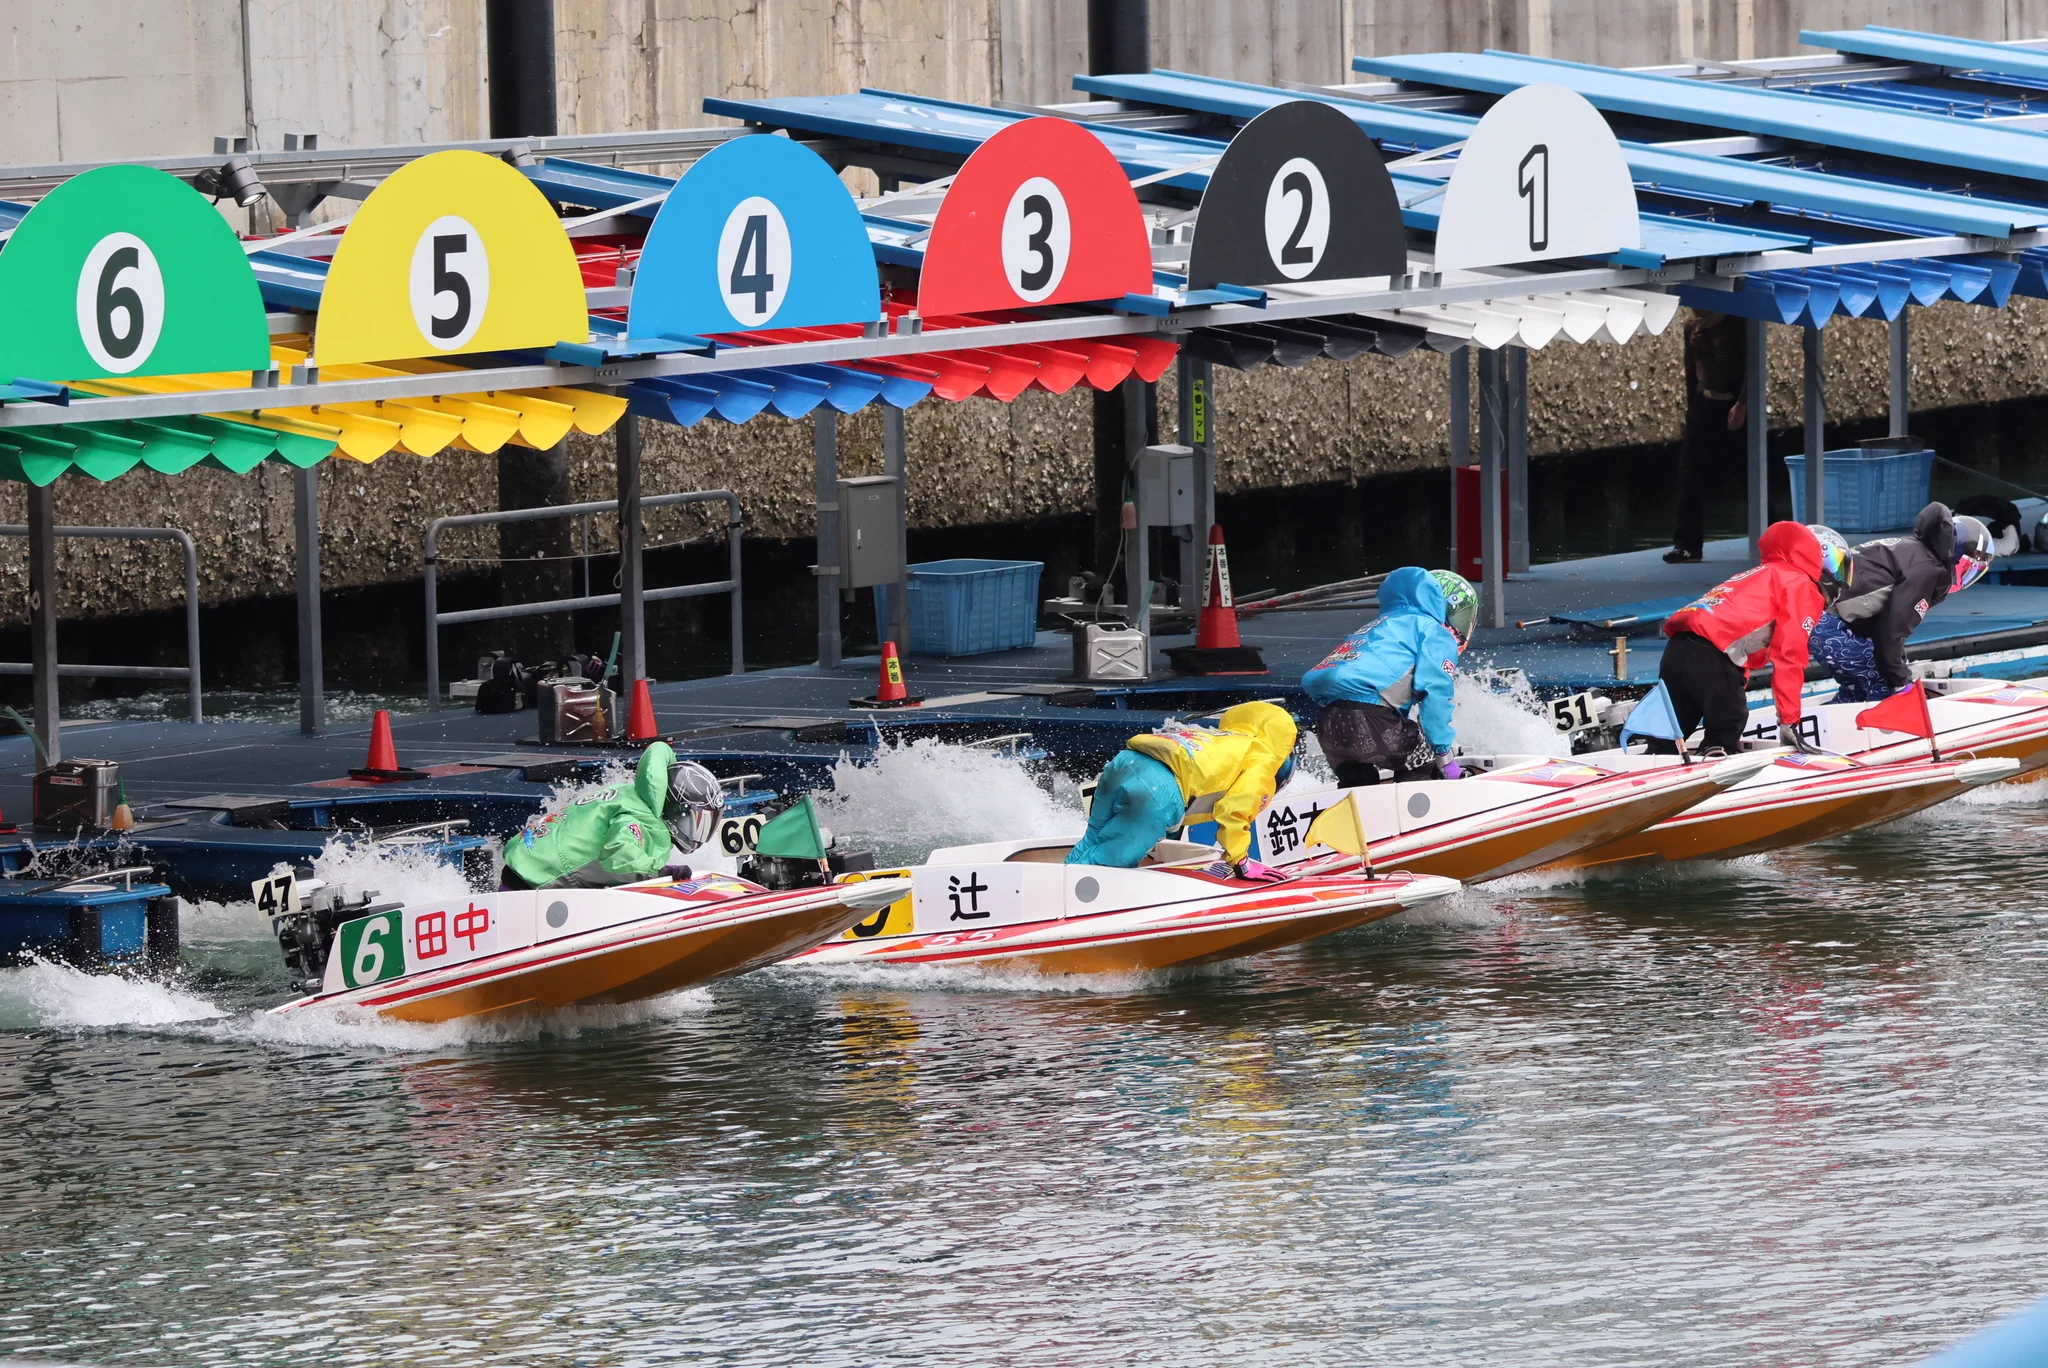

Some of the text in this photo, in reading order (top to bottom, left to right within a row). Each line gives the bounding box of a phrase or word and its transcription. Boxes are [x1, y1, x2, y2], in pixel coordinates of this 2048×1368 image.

[1281, 171, 1314, 266] 2
[1518, 144, 1549, 252] 1
[730, 215, 774, 314] 4
[1021, 194, 1054, 291] 3
[96, 246, 144, 359] 6
[431, 234, 471, 339] 5
[888, 660, 900, 683] 本番
[1554, 694, 1593, 731] 51
[721, 817, 763, 854] 60
[258, 876, 292, 916] 47
[415, 902, 490, 960] 田中
[948, 871, 991, 922] 辻
[352, 916, 391, 987] 6
